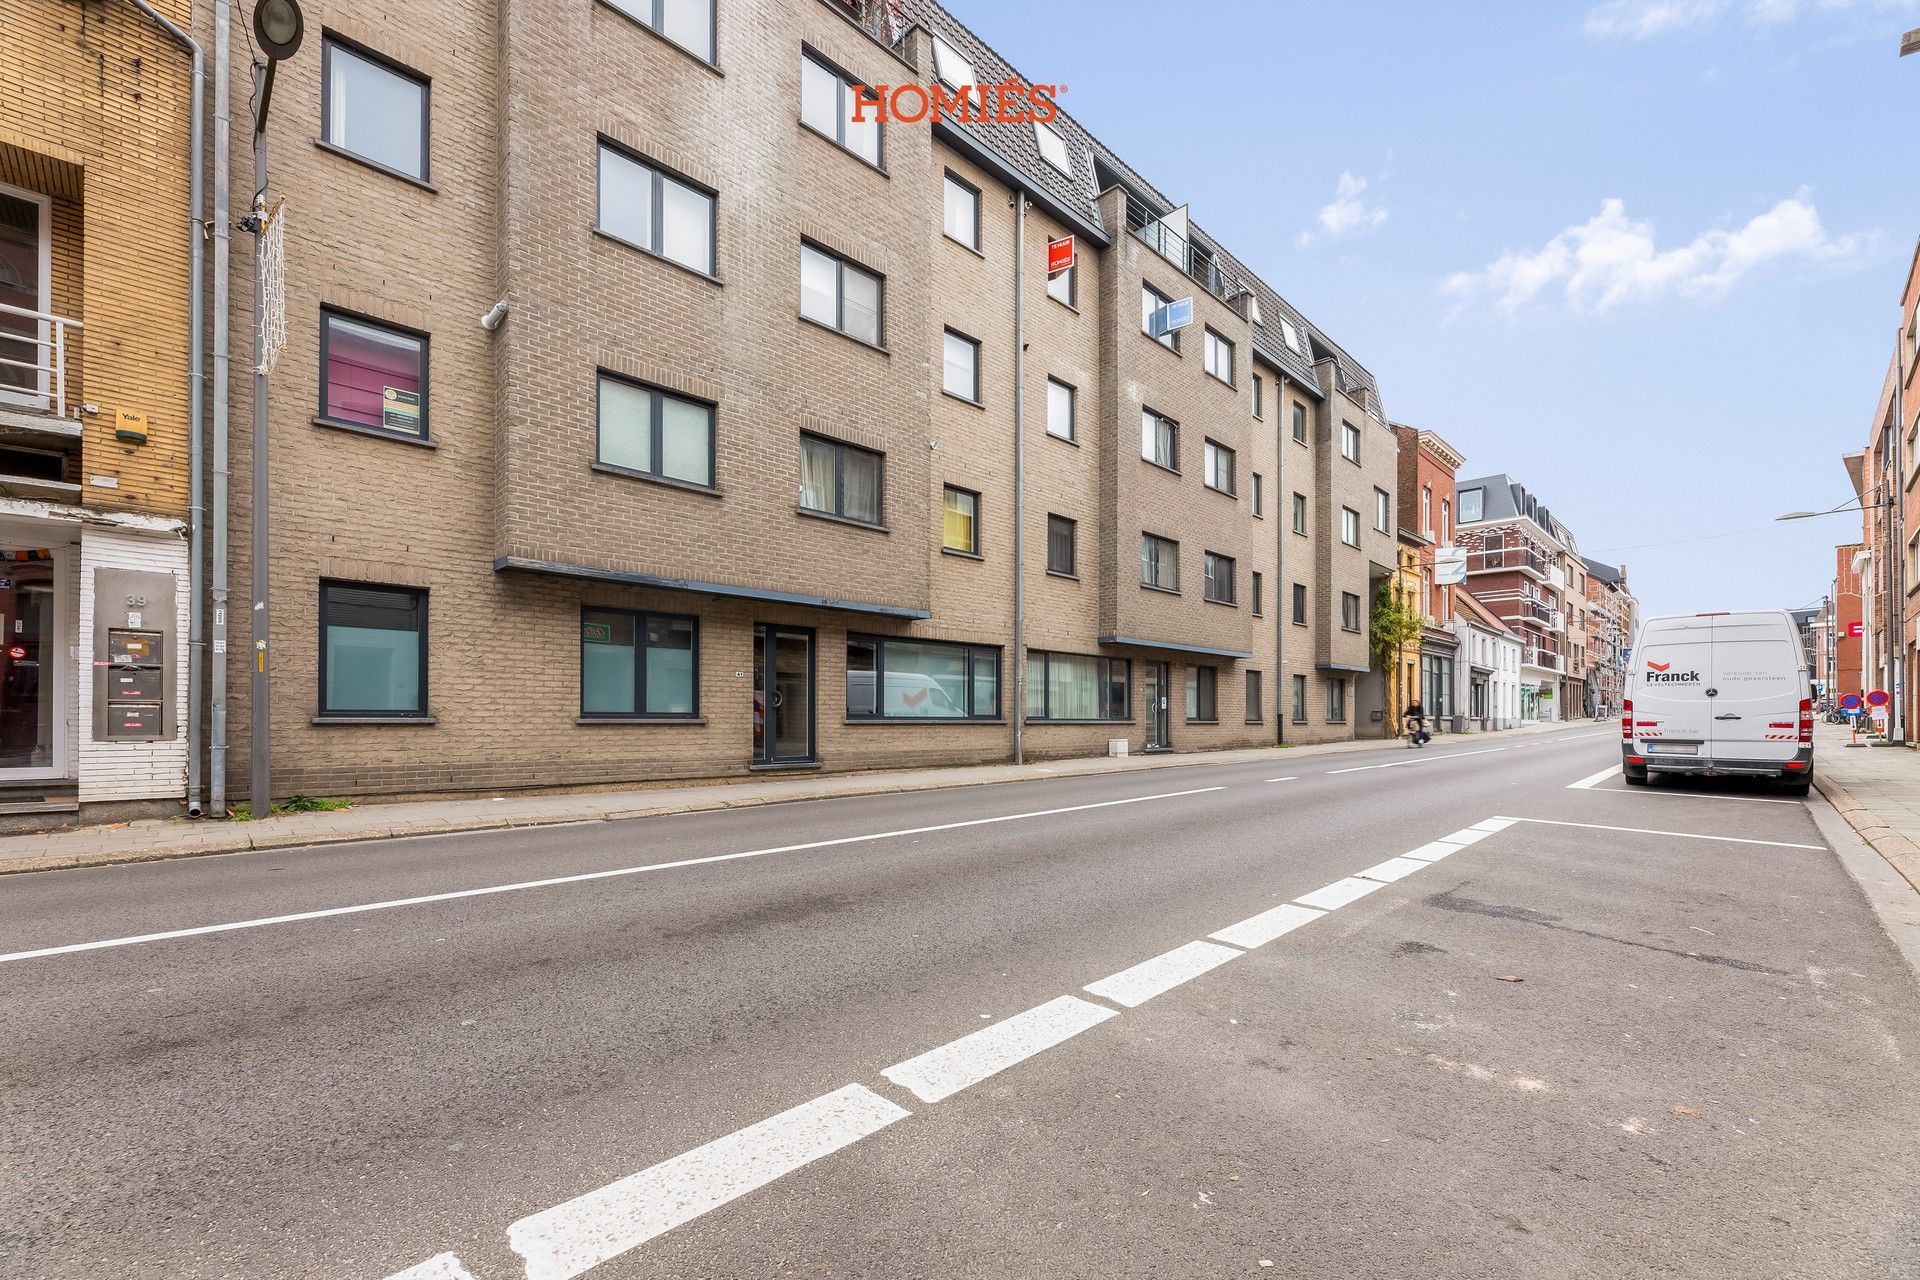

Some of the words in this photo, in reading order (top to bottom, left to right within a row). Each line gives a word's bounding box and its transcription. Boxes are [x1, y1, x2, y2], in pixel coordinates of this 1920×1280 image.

[122, 413, 141, 422] Yale
[126, 594, 147, 606] 39
[1646, 670, 1700, 682] Franck
